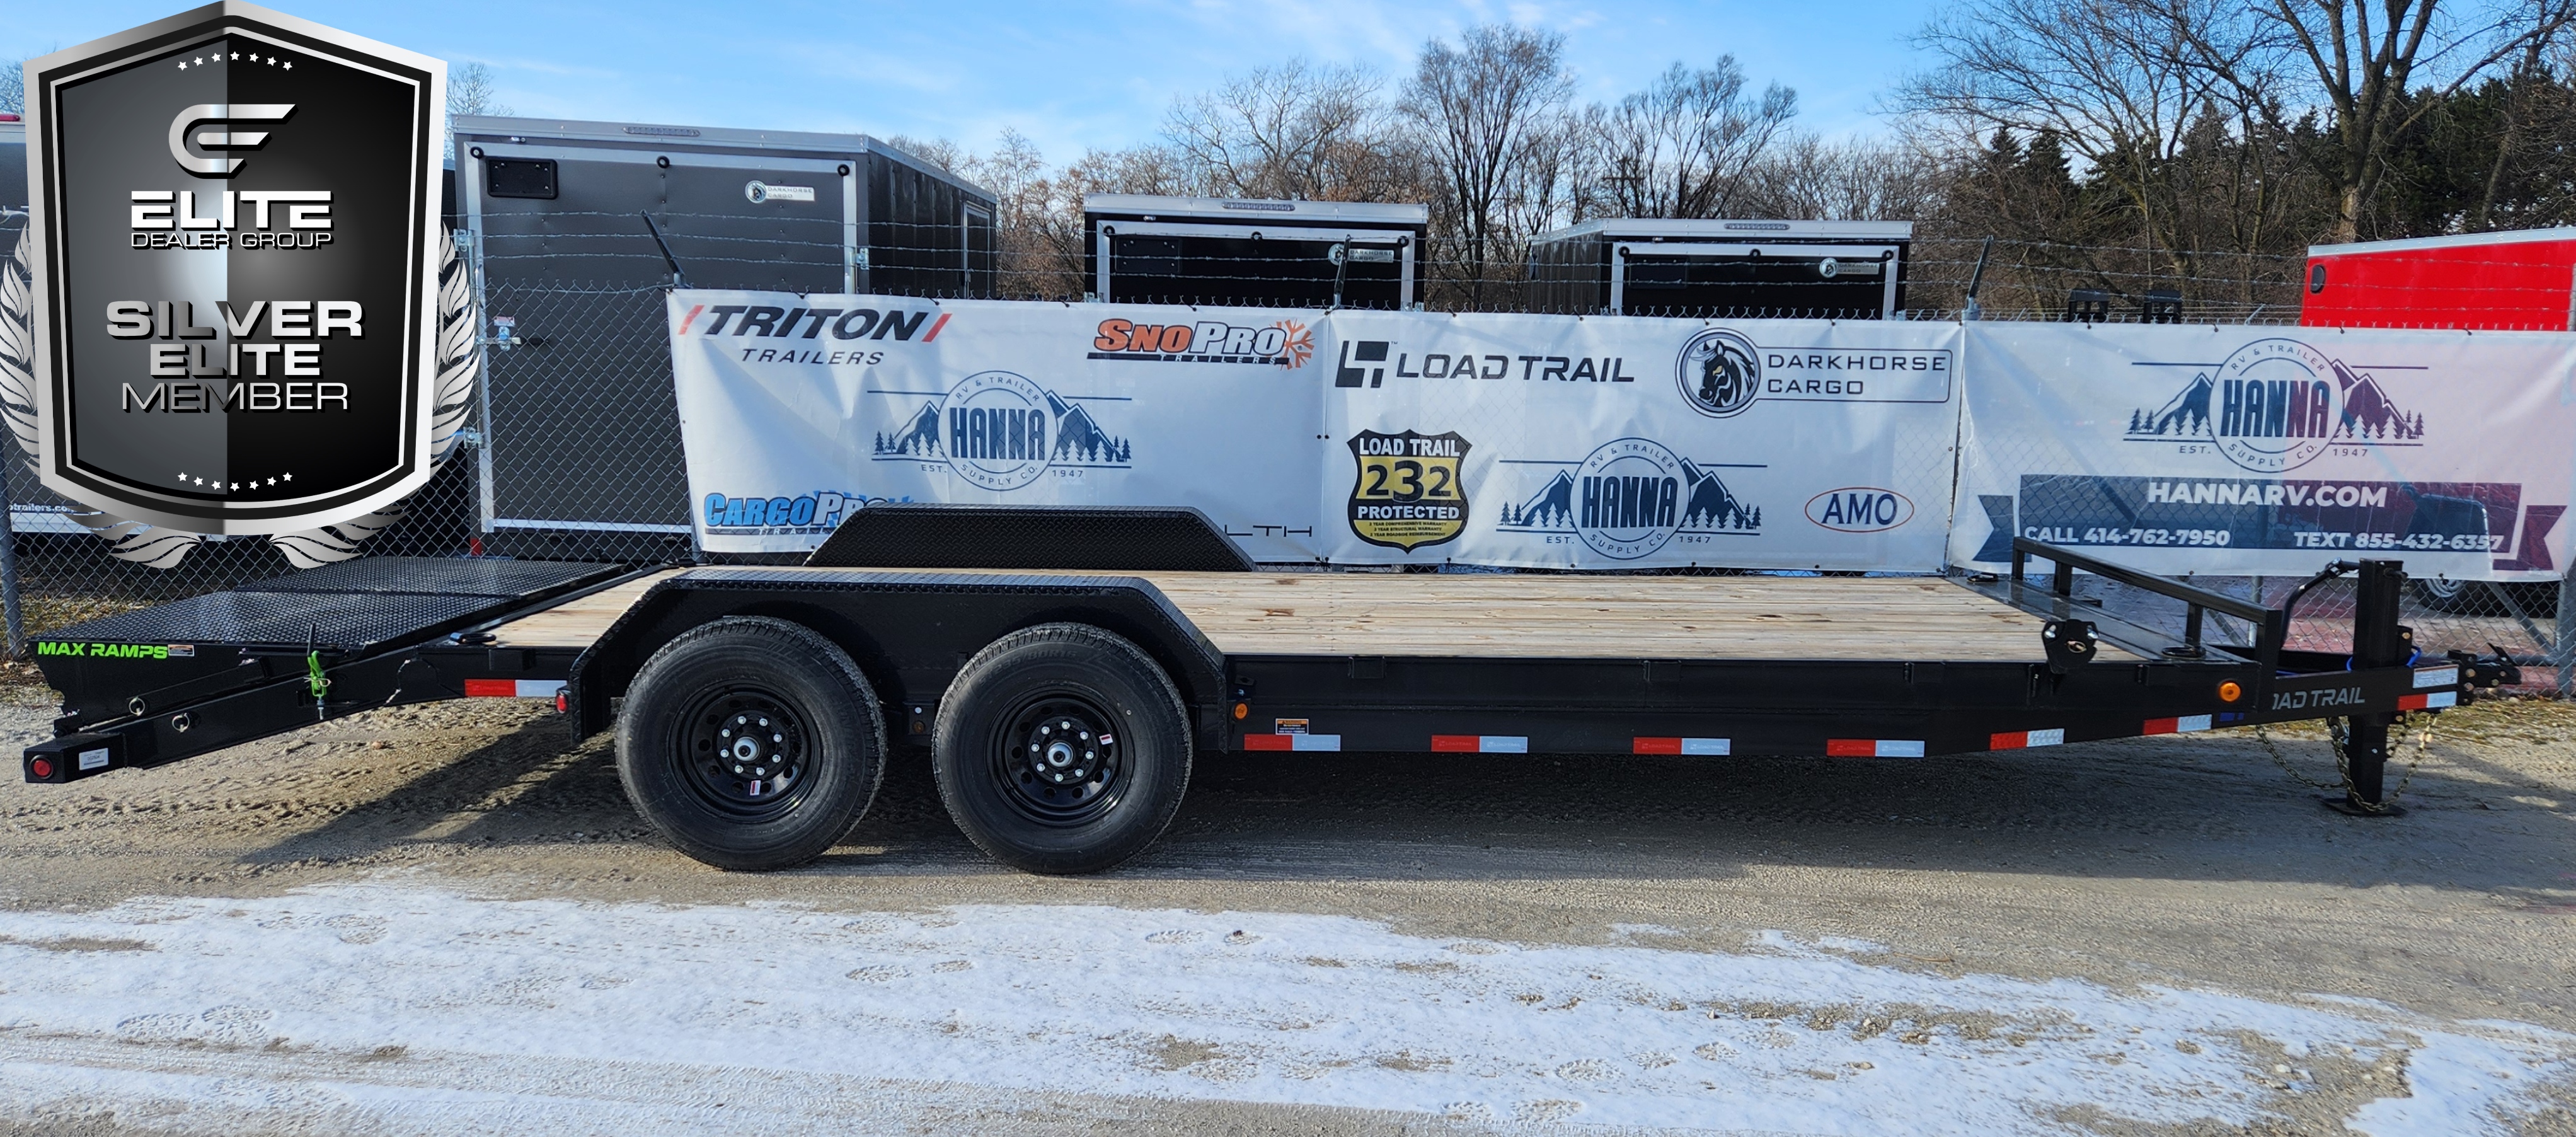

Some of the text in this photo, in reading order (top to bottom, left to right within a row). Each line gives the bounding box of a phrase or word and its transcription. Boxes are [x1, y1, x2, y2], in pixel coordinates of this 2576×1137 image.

[705, 305, 928, 341] TRITON
[742, 349, 884, 366] TRAILERS
[1159, 354, 1277, 364] TRAILERS
[1396, 353, 1635, 383] LOAD TRAIL
[1768, 355, 1946, 371] DARKHORSE
[2231, 355, 2246, 371] RV
[2268, 345, 2325, 371] TRAILER
[956, 386, 969, 400] RV
[989, 377, 1039, 401] TRAILER
[1768, 379, 1864, 395] CARGO
[2220, 379, 2330, 438] HANNA
[950, 407, 1045, 461] HANNA
[1359, 437, 1460, 457] LOAD TRAIL
[1590, 454, 1603, 468] RV
[1624, 444, 1674, 469] TRAILER
[2180, 446, 2211, 454] EST.
[2229, 443, 2318, 466] SUPPLY CO.
[2333, 448, 2368, 456] 1947
[921, 464, 947, 473] EST.
[960, 464, 1038, 485] SUPPLY CO.
[1366, 460, 1451, 502] 232
[1581, 476, 1678, 528] HANNA
[2148, 482, 2388, 508] HANNARV.COM
[1357, 505, 1460, 519] PROTECTED
[1821, 493, 1898, 525] AMO
[1590, 533, 1665, 554] SUPPLY CO.
[2025, 526, 2231, 546] CALL 414-762-7950
[2294, 531, 2504, 551] TEXT 855-432-6357
[38, 642, 86, 656] MAX
[91, 644, 168, 659] RAMPS
[2311, 687, 2365, 707] TRAIL
